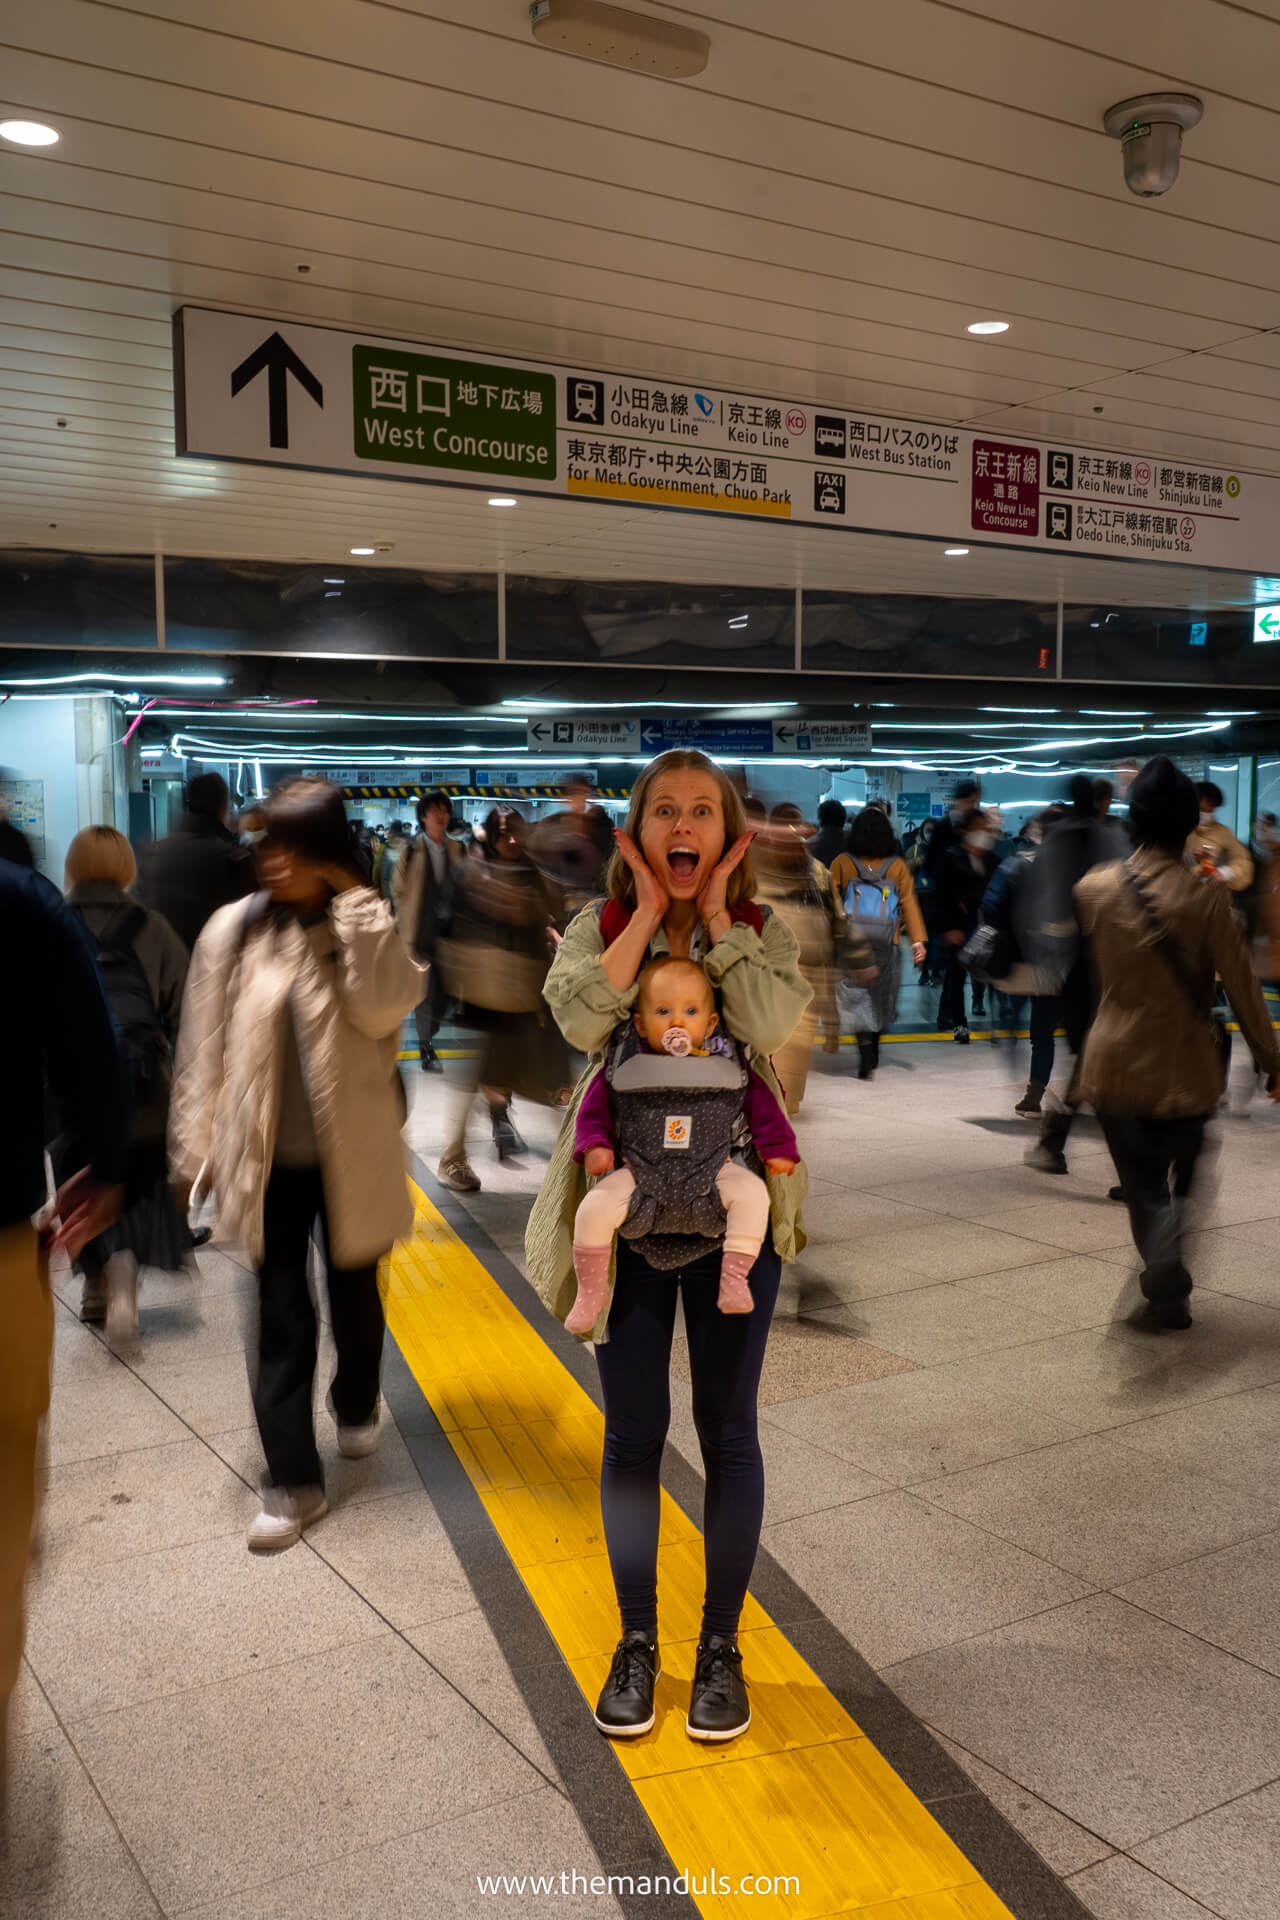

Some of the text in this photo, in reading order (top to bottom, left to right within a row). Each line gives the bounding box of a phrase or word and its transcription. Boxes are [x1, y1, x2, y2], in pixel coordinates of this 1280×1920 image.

[368, 366, 544, 417] 西口 地下広場
[611, 385, 689, 416] 小田急線
[611, 409, 699, 437] Odakyu Line
[728, 402, 782, 430] 京王線
[363, 417, 549, 465] West Concourse
[728, 427, 789, 449] Keio Line
[849, 421, 959, 454] 西口バスのりば
[567, 439, 767, 485] 東京都庁・中央公園方面
[850, 444, 951, 471] West Bus Station
[976, 448, 1037, 484] 京王新線
[1077, 456, 1132, 480] 京王新線
[567, 464, 589, 481] for
[724, 483, 758, 501] Chuo
[763, 488, 791, 505] Park
[816, 473, 843, 487] TAXI
[993, 483, 1019, 500] 通路
[1077, 477, 1148, 498] Keio New Line
[1159, 468, 1223, 493] 都営新宿線
[975, 498, 1036, 517] Keio New Line
[1159, 488, 1223, 509] Shinjuku Line
[983, 512, 1028, 529] Concourse
[1084, 507, 1178, 536] 大江戸線新宿駅
[1076, 526, 1192, 553] Oedo Line, Shinjuku Sta.
[577, 734, 627, 744] Odakyu Line
